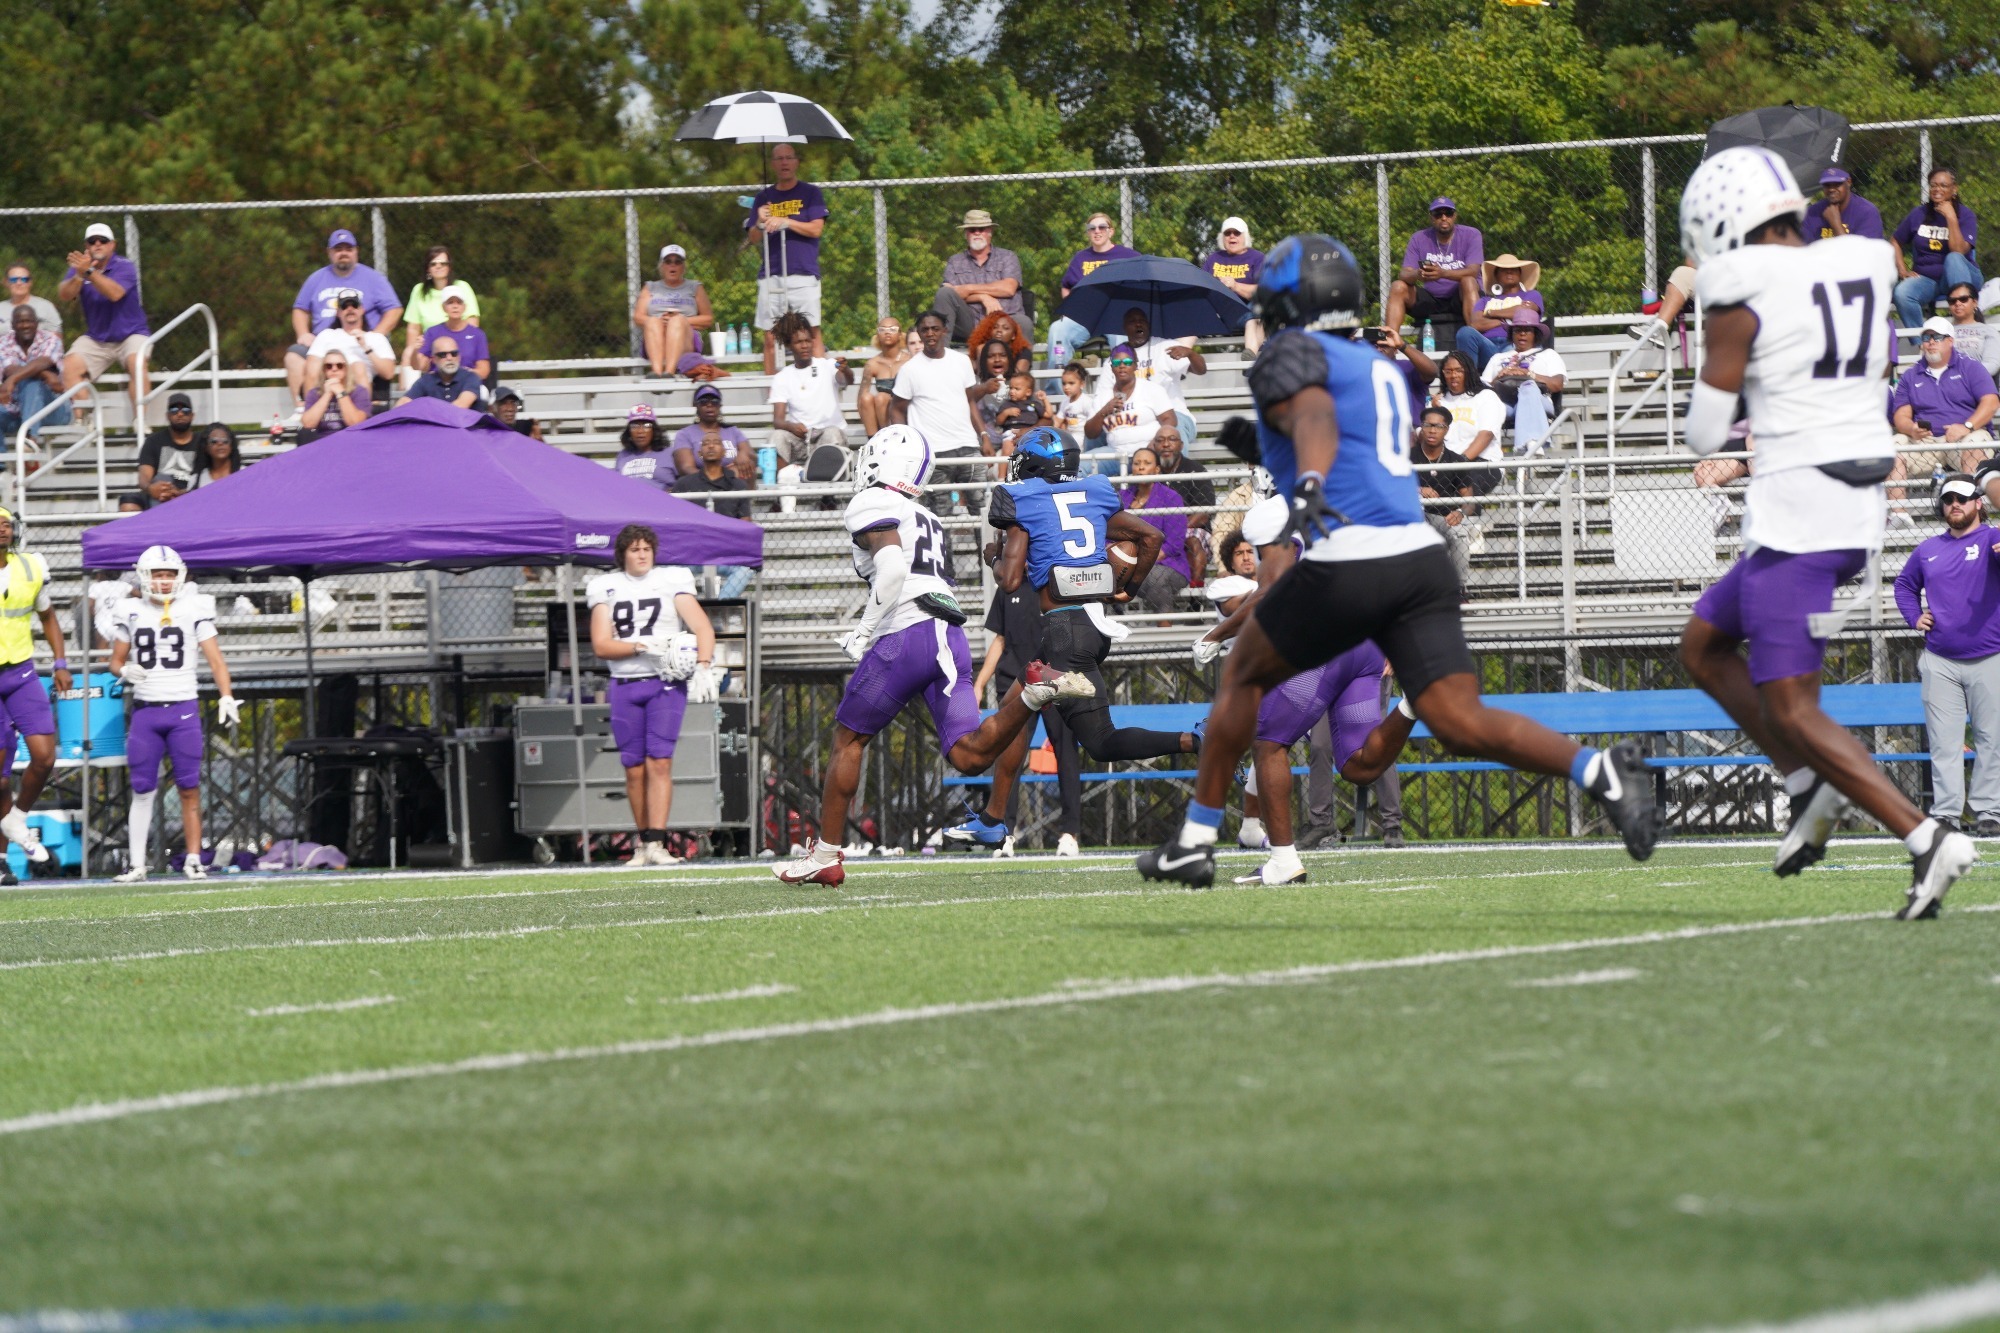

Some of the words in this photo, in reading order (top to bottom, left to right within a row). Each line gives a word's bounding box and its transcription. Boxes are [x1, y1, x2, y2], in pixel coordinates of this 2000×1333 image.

[1917, 224, 1949, 240] BETH
[1082, 260, 1108, 270] BET
[1426, 252, 1454, 263] Bethel
[1213, 262, 1250, 272] BETHEL
[1811, 277, 1875, 379] 17
[1103, 413, 1138, 432] MOM
[1371, 358, 1413, 477] 0
[897, 481, 923, 496] Riddel
[1051, 490, 1097, 559] 5
[576, 532, 611, 546] Academy
[910, 510, 948, 577] 23
[1069, 570, 1103, 584] schutt
[612, 597, 662, 638] 87
[135, 626, 184, 670] 83
